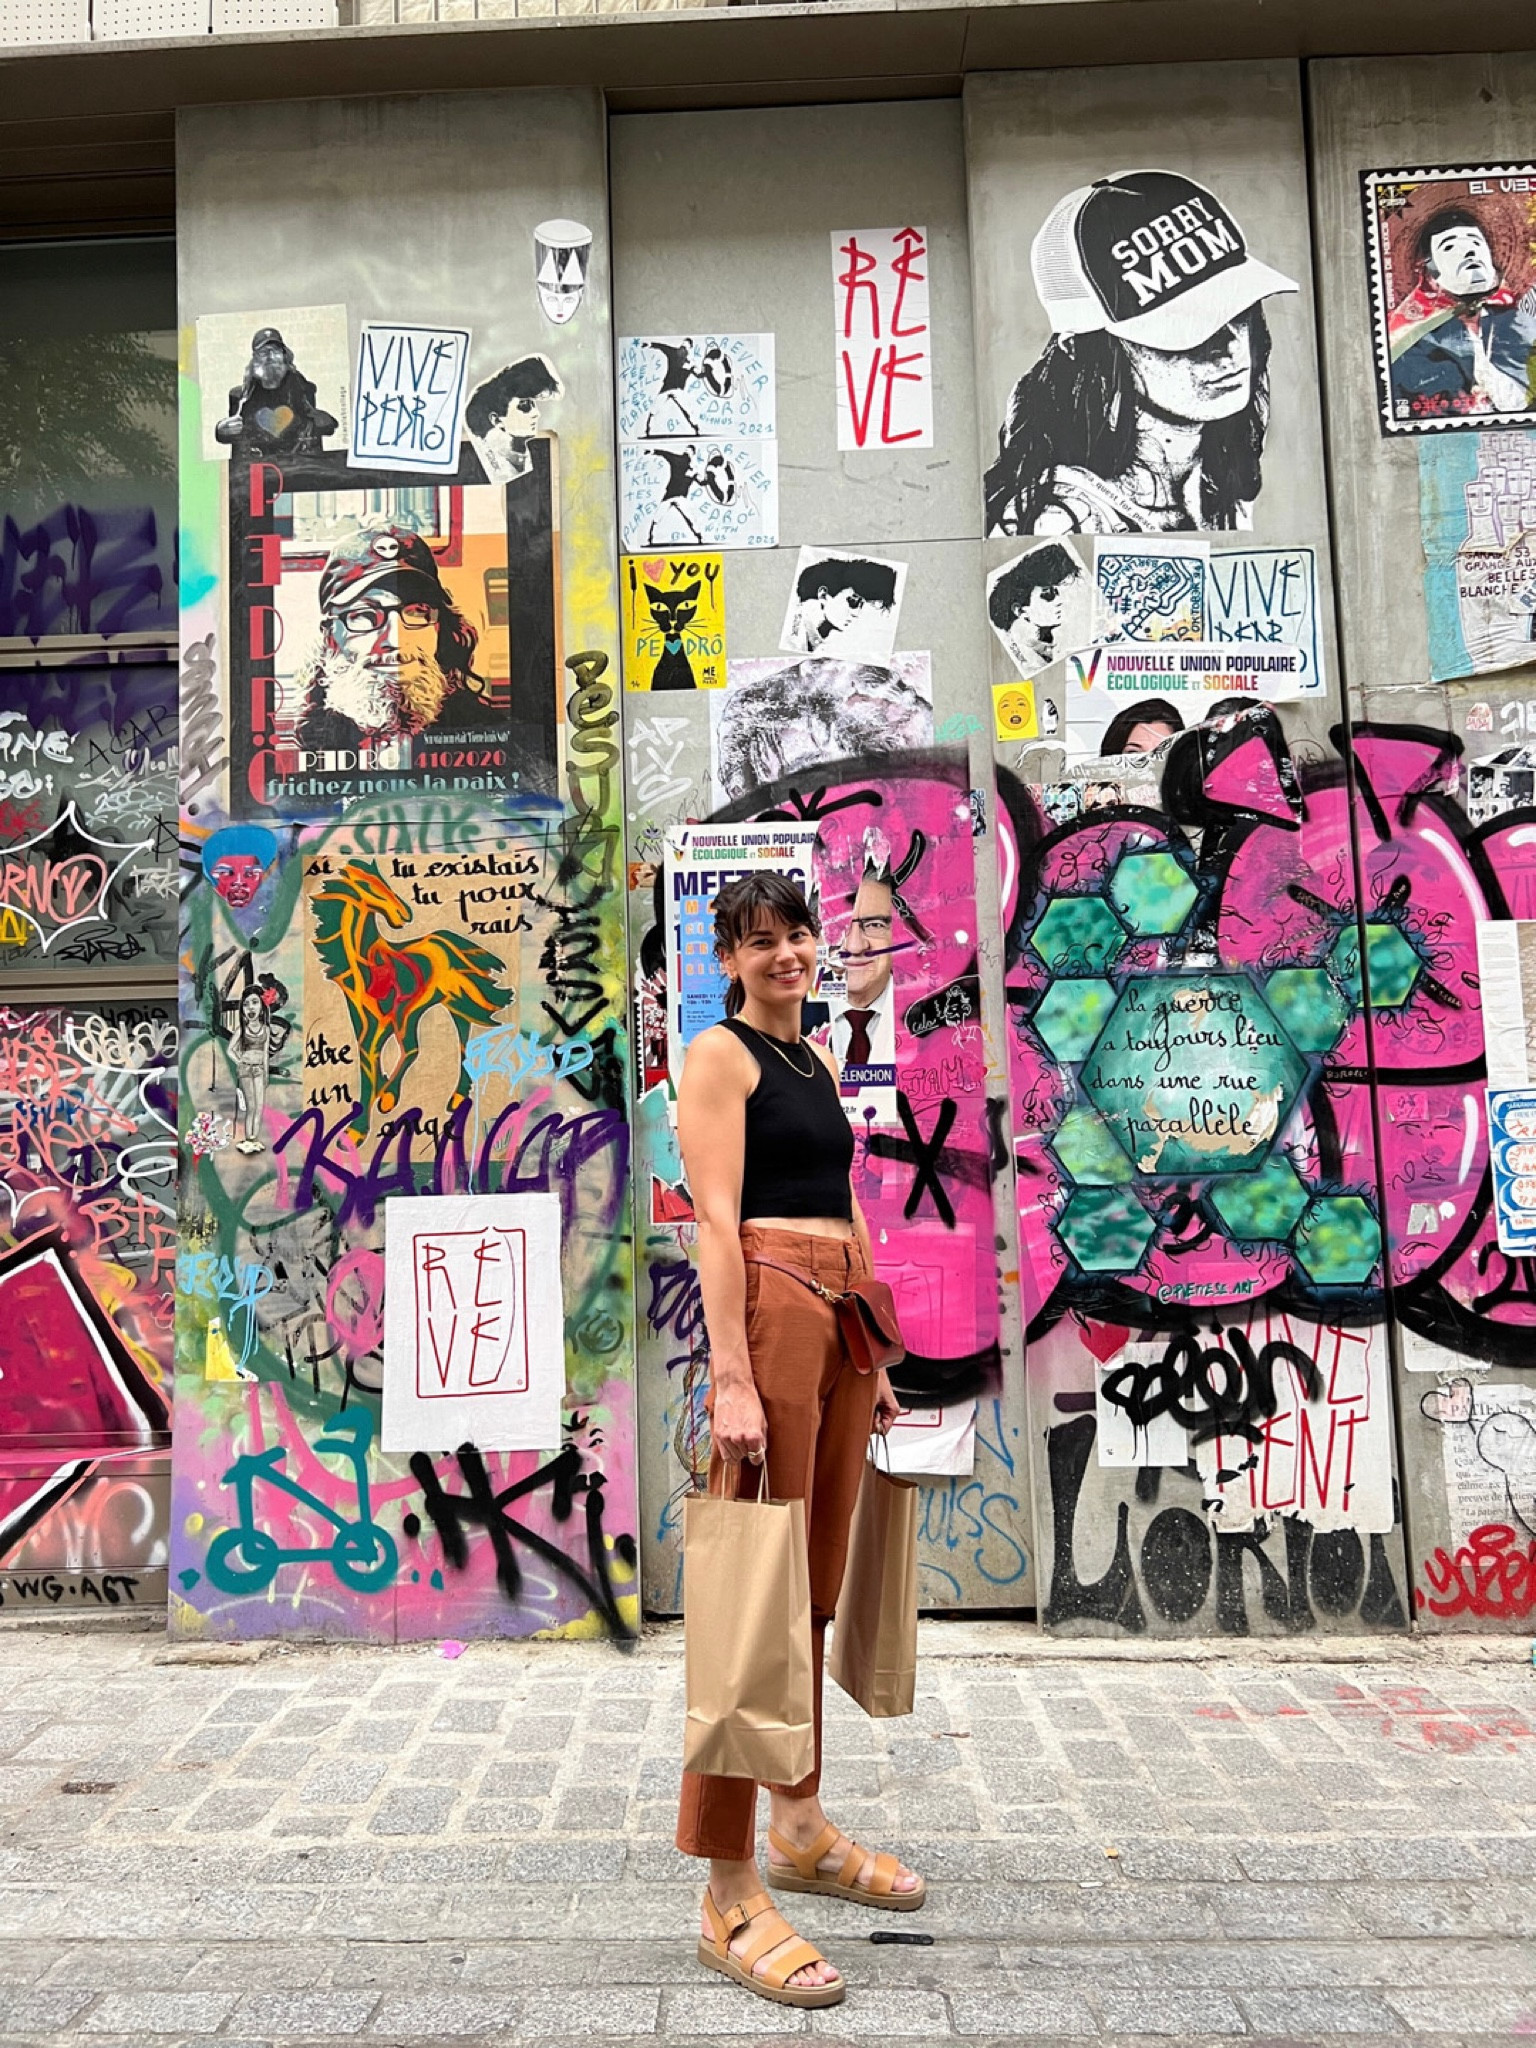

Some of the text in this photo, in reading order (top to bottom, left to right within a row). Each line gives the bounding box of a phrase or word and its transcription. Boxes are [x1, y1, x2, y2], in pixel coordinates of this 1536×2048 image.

[1469, 180, 1494, 195] EL
[1110, 197, 1217, 270] SORRY
[1122, 218, 1241, 307] MOM
[367, 333, 456, 395] VIVE
[361, 391, 446, 452] PEDRO
[738, 422, 774, 435] 2021
[1514, 547, 1530, 558] 53
[1488, 568, 1536, 583] BELLES
[1209, 559, 1301, 619] VIVE
[1460, 583, 1520, 598] BLANCHE
[1107, 655, 1297, 672] NOUVELLE UNION POPULAIRE
[1107, 672, 1188, 691] ÉCOLOGIQUE
[1203, 673, 1258, 691] SOCIALE
[267, 776, 351, 797] frichez
[359, 777, 417, 795] nous
[423, 774, 447, 791] la
[453, 771, 508, 793] paix
[692, 832, 816, 847] NOUVELLE UNION POPULAIR
[692, 847, 748, 861] ÉCOLOGIQUE
[758, 846, 796, 859] SOCIALE
[391, 855, 418, 878] tu
[424, 853, 540, 878] existais
[412, 883, 439, 906] tu
[468, 912, 535, 936] rais
[1125, 990, 1243, 1026] la guerre
[306, 1038, 355, 1068] être
[1101, 1018, 1283, 1073] a toujours lieu
[840, 1068, 893, 1082] ELENCHON
[1090, 1070, 1261, 1091] dans une rue
[307, 1083, 353, 1106] un
[1123, 1097, 1257, 1152] parallèle
